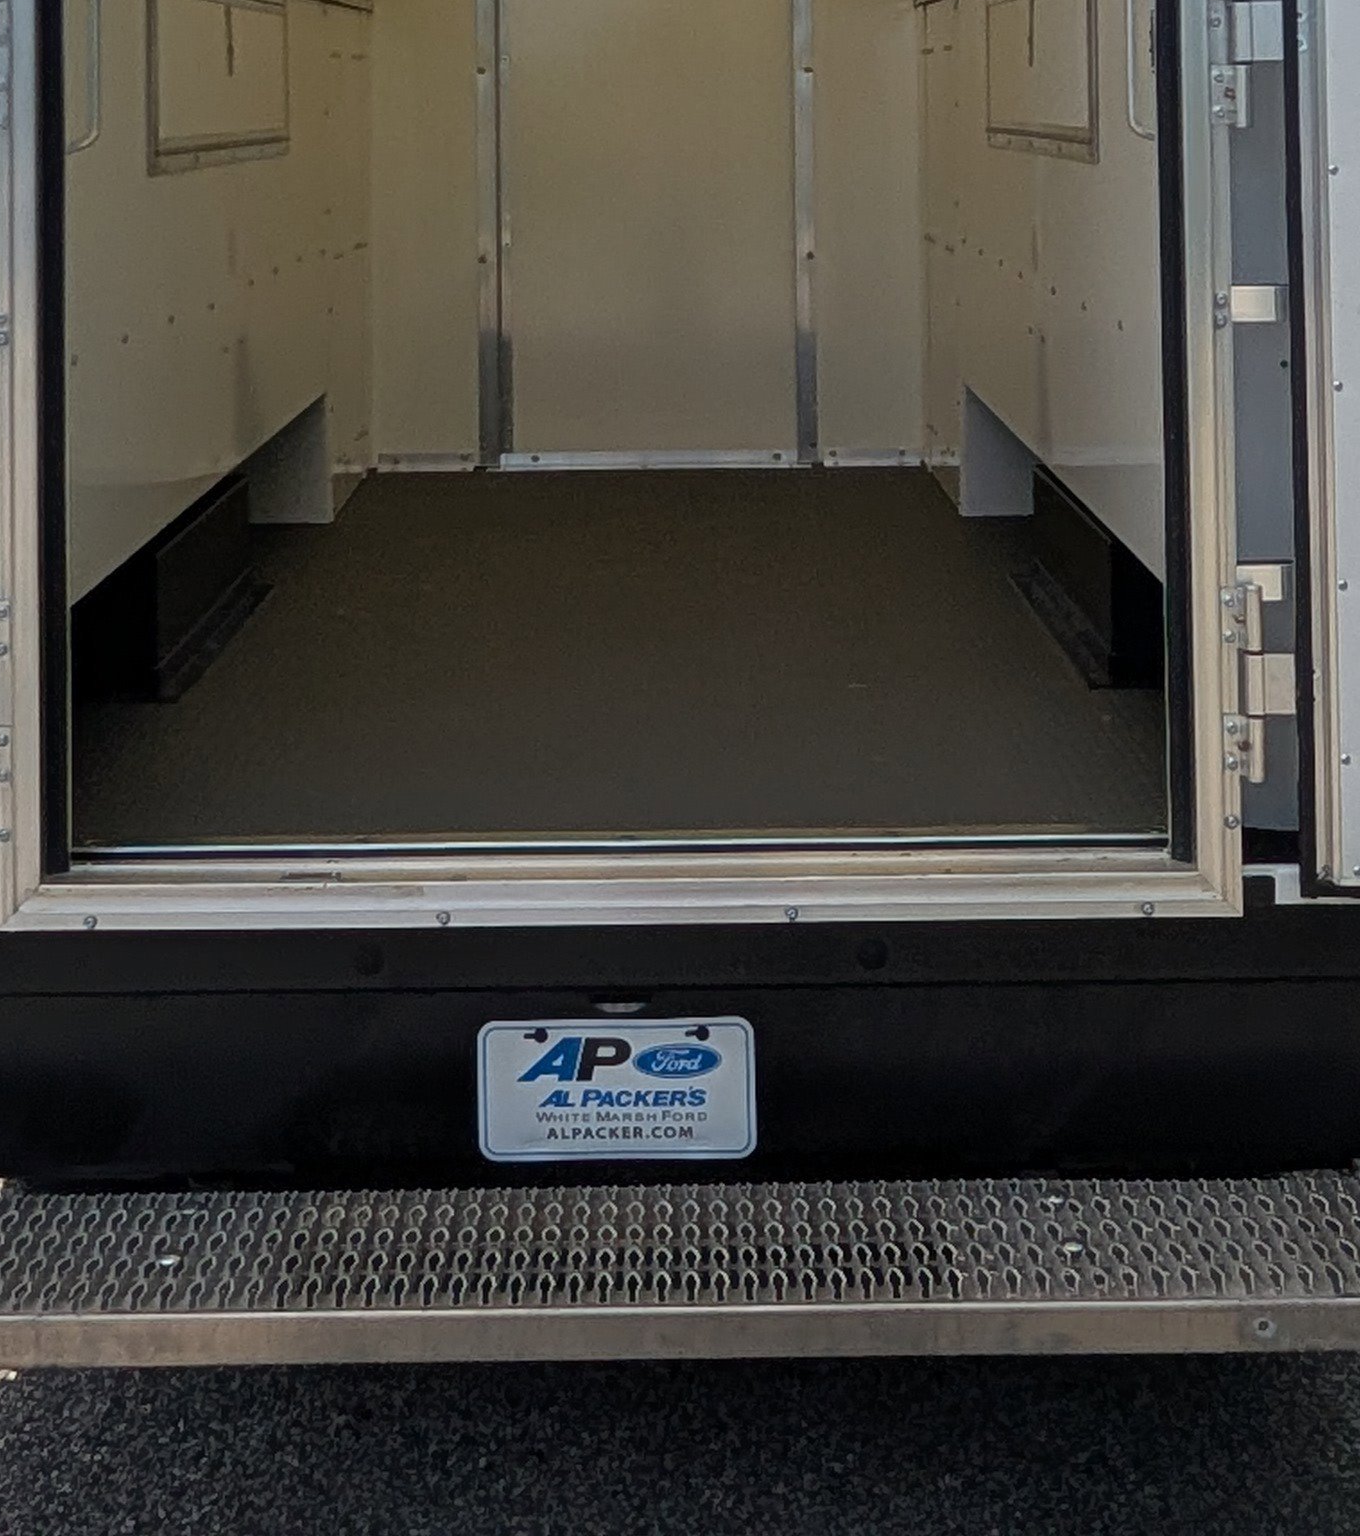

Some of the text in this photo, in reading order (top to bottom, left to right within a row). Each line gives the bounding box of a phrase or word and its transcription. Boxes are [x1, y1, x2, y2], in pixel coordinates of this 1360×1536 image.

[516, 1036, 633, 1083] AP
[650, 1048, 703, 1072] Ford
[539, 1089, 576, 1108] AL
[546, 1126, 695, 1141] ALPACKER.COM
